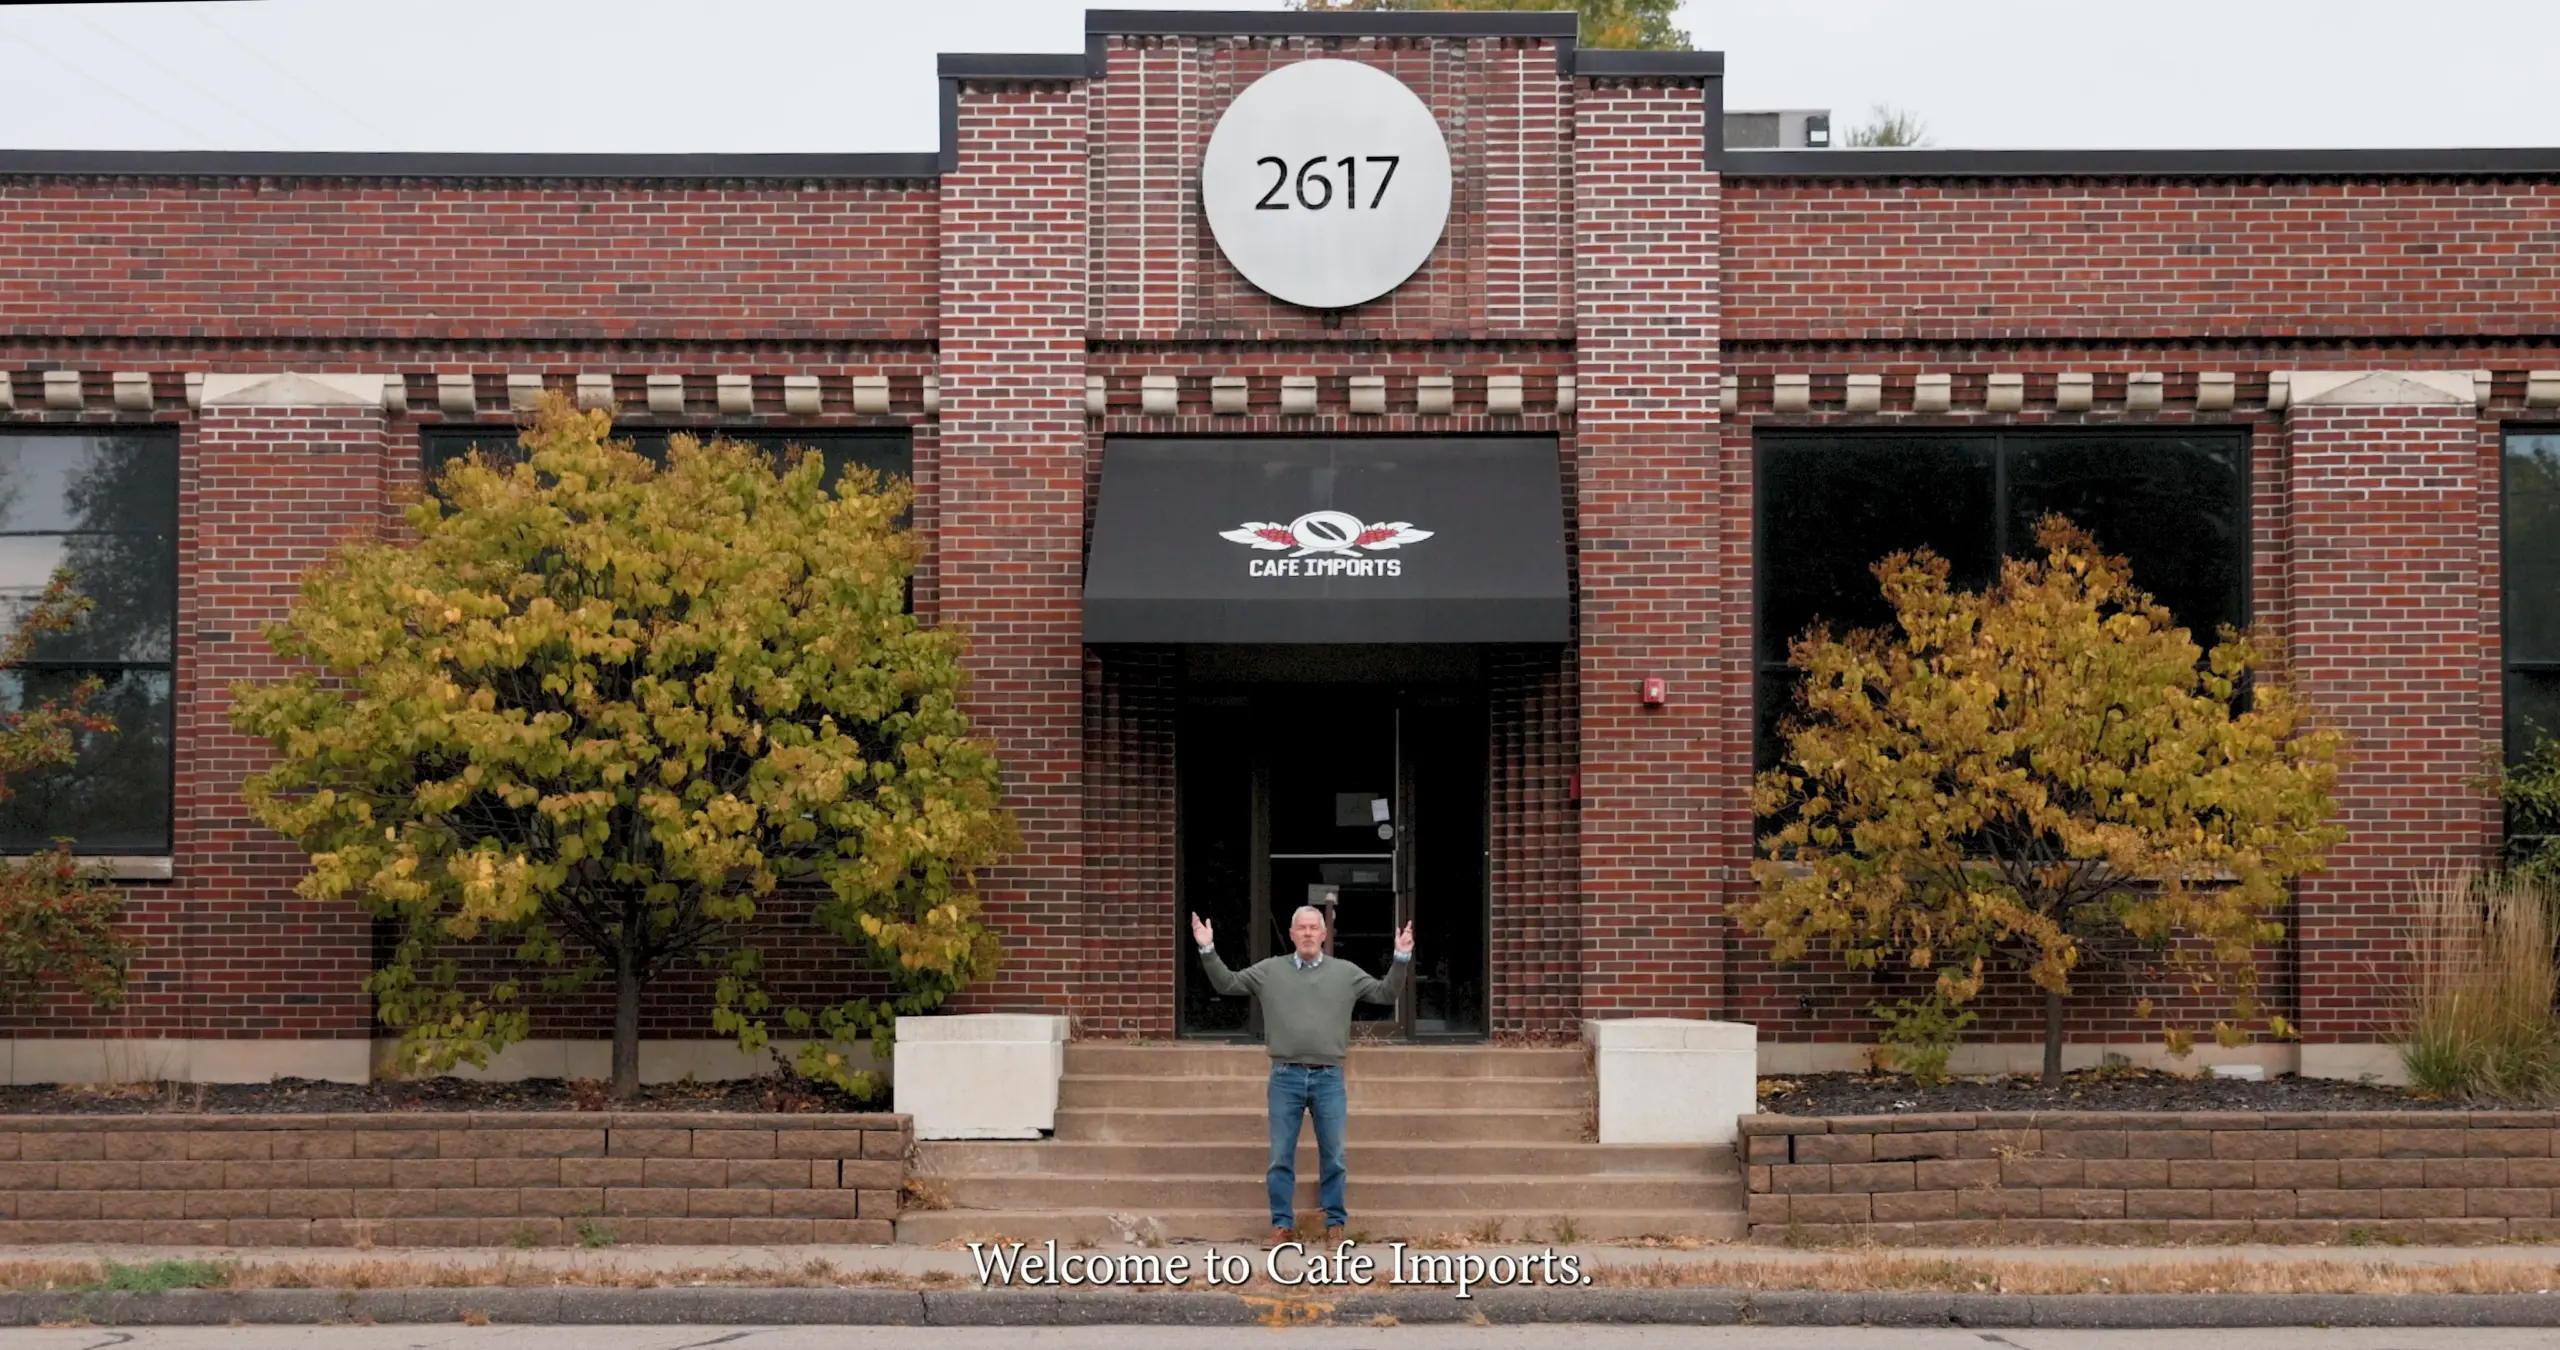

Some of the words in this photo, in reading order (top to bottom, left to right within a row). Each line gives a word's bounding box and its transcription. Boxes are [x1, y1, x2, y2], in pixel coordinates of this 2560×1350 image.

[1255, 155, 1400, 211] 2617
[1249, 558, 1300, 577] CAFE
[1303, 558, 1402, 577] IMPORTS
